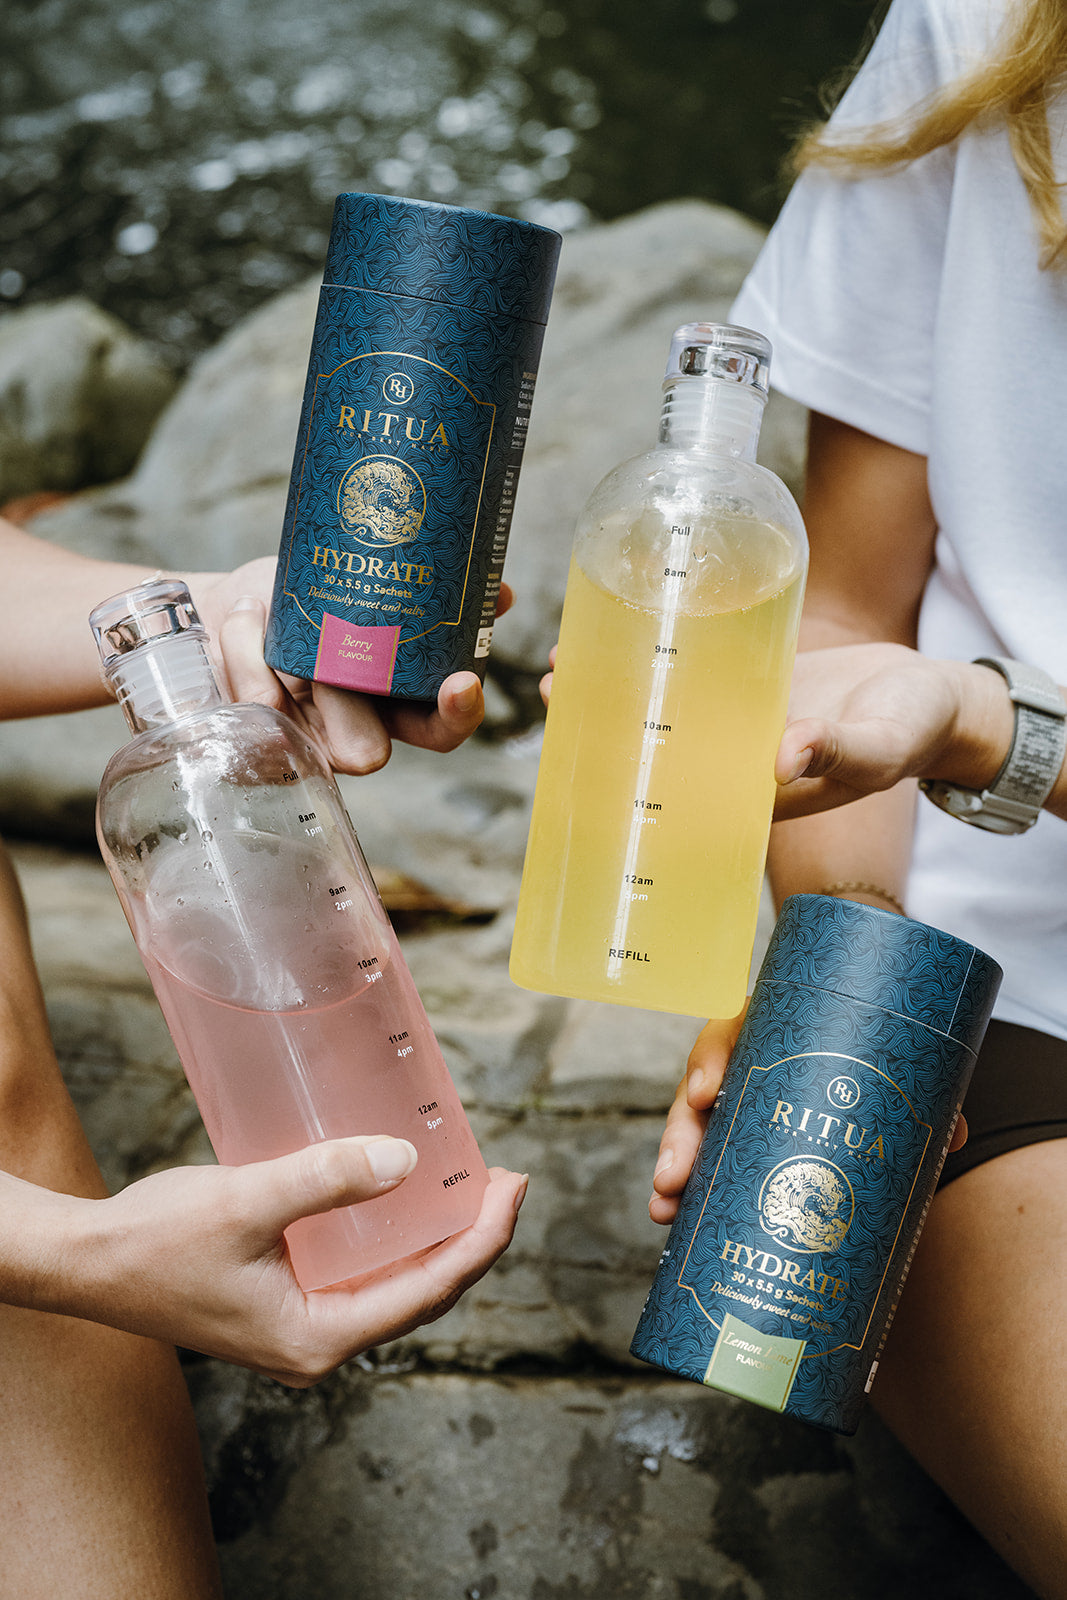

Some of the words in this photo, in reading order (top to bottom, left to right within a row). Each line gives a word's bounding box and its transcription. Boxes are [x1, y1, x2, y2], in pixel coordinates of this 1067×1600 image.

[337, 405, 450, 446] RITUA
[671, 525, 690, 536] Full
[311, 545, 434, 585] HYDRATE
[664, 567, 687, 578] 8am
[324, 574, 336, 585] 30
[345, 578, 361, 590] 5.5
[363, 584, 371, 594] g
[373, 584, 412, 599] Sachets
[308, 585, 354, 606] Deliciously
[354, 599, 379, 610] sweet
[381, 601, 401, 612] and
[401, 605, 426, 618] salty
[341, 633, 373, 652] Berry
[655, 644, 678, 655] 9am
[337, 649, 373, 662] FLAVOUR
[643, 721, 672, 732] 10am
[283, 770, 299, 783] Full
[634, 799, 662, 811] 11am
[298, 811, 316, 823] 8am
[304, 825, 323, 837] 1pm
[625, 874, 654, 886] 12am
[329, 885, 347, 897] 9am
[335, 898, 353, 911] 2pm
[357, 956, 379, 970] 10am
[608, 949, 650, 963] REFILL
[365, 970, 383, 983] 3pm
[388, 1029, 409, 1044] 11am
[397, 1045, 414, 1058] 4pm
[418, 1100, 439, 1116] 12am
[427, 1116, 444, 1130] 5pm
[770, 1099, 885, 1160] RITUA
[442, 1169, 470, 1189] REFILL
[719, 1239, 848, 1301] HYDRATE
[731, 1270, 746, 1284] 30
[746, 1277, 754, 1287] x
[755, 1278, 774, 1293] 5.5
[774, 1289, 783, 1300] g
[785, 1289, 824, 1312] Sachets
[710, 1280, 763, 1310] Deliciously
[762, 1302, 791, 1318] sweet
[790, 1312, 811, 1325] and
[723, 1331, 762, 1355] Lemon
